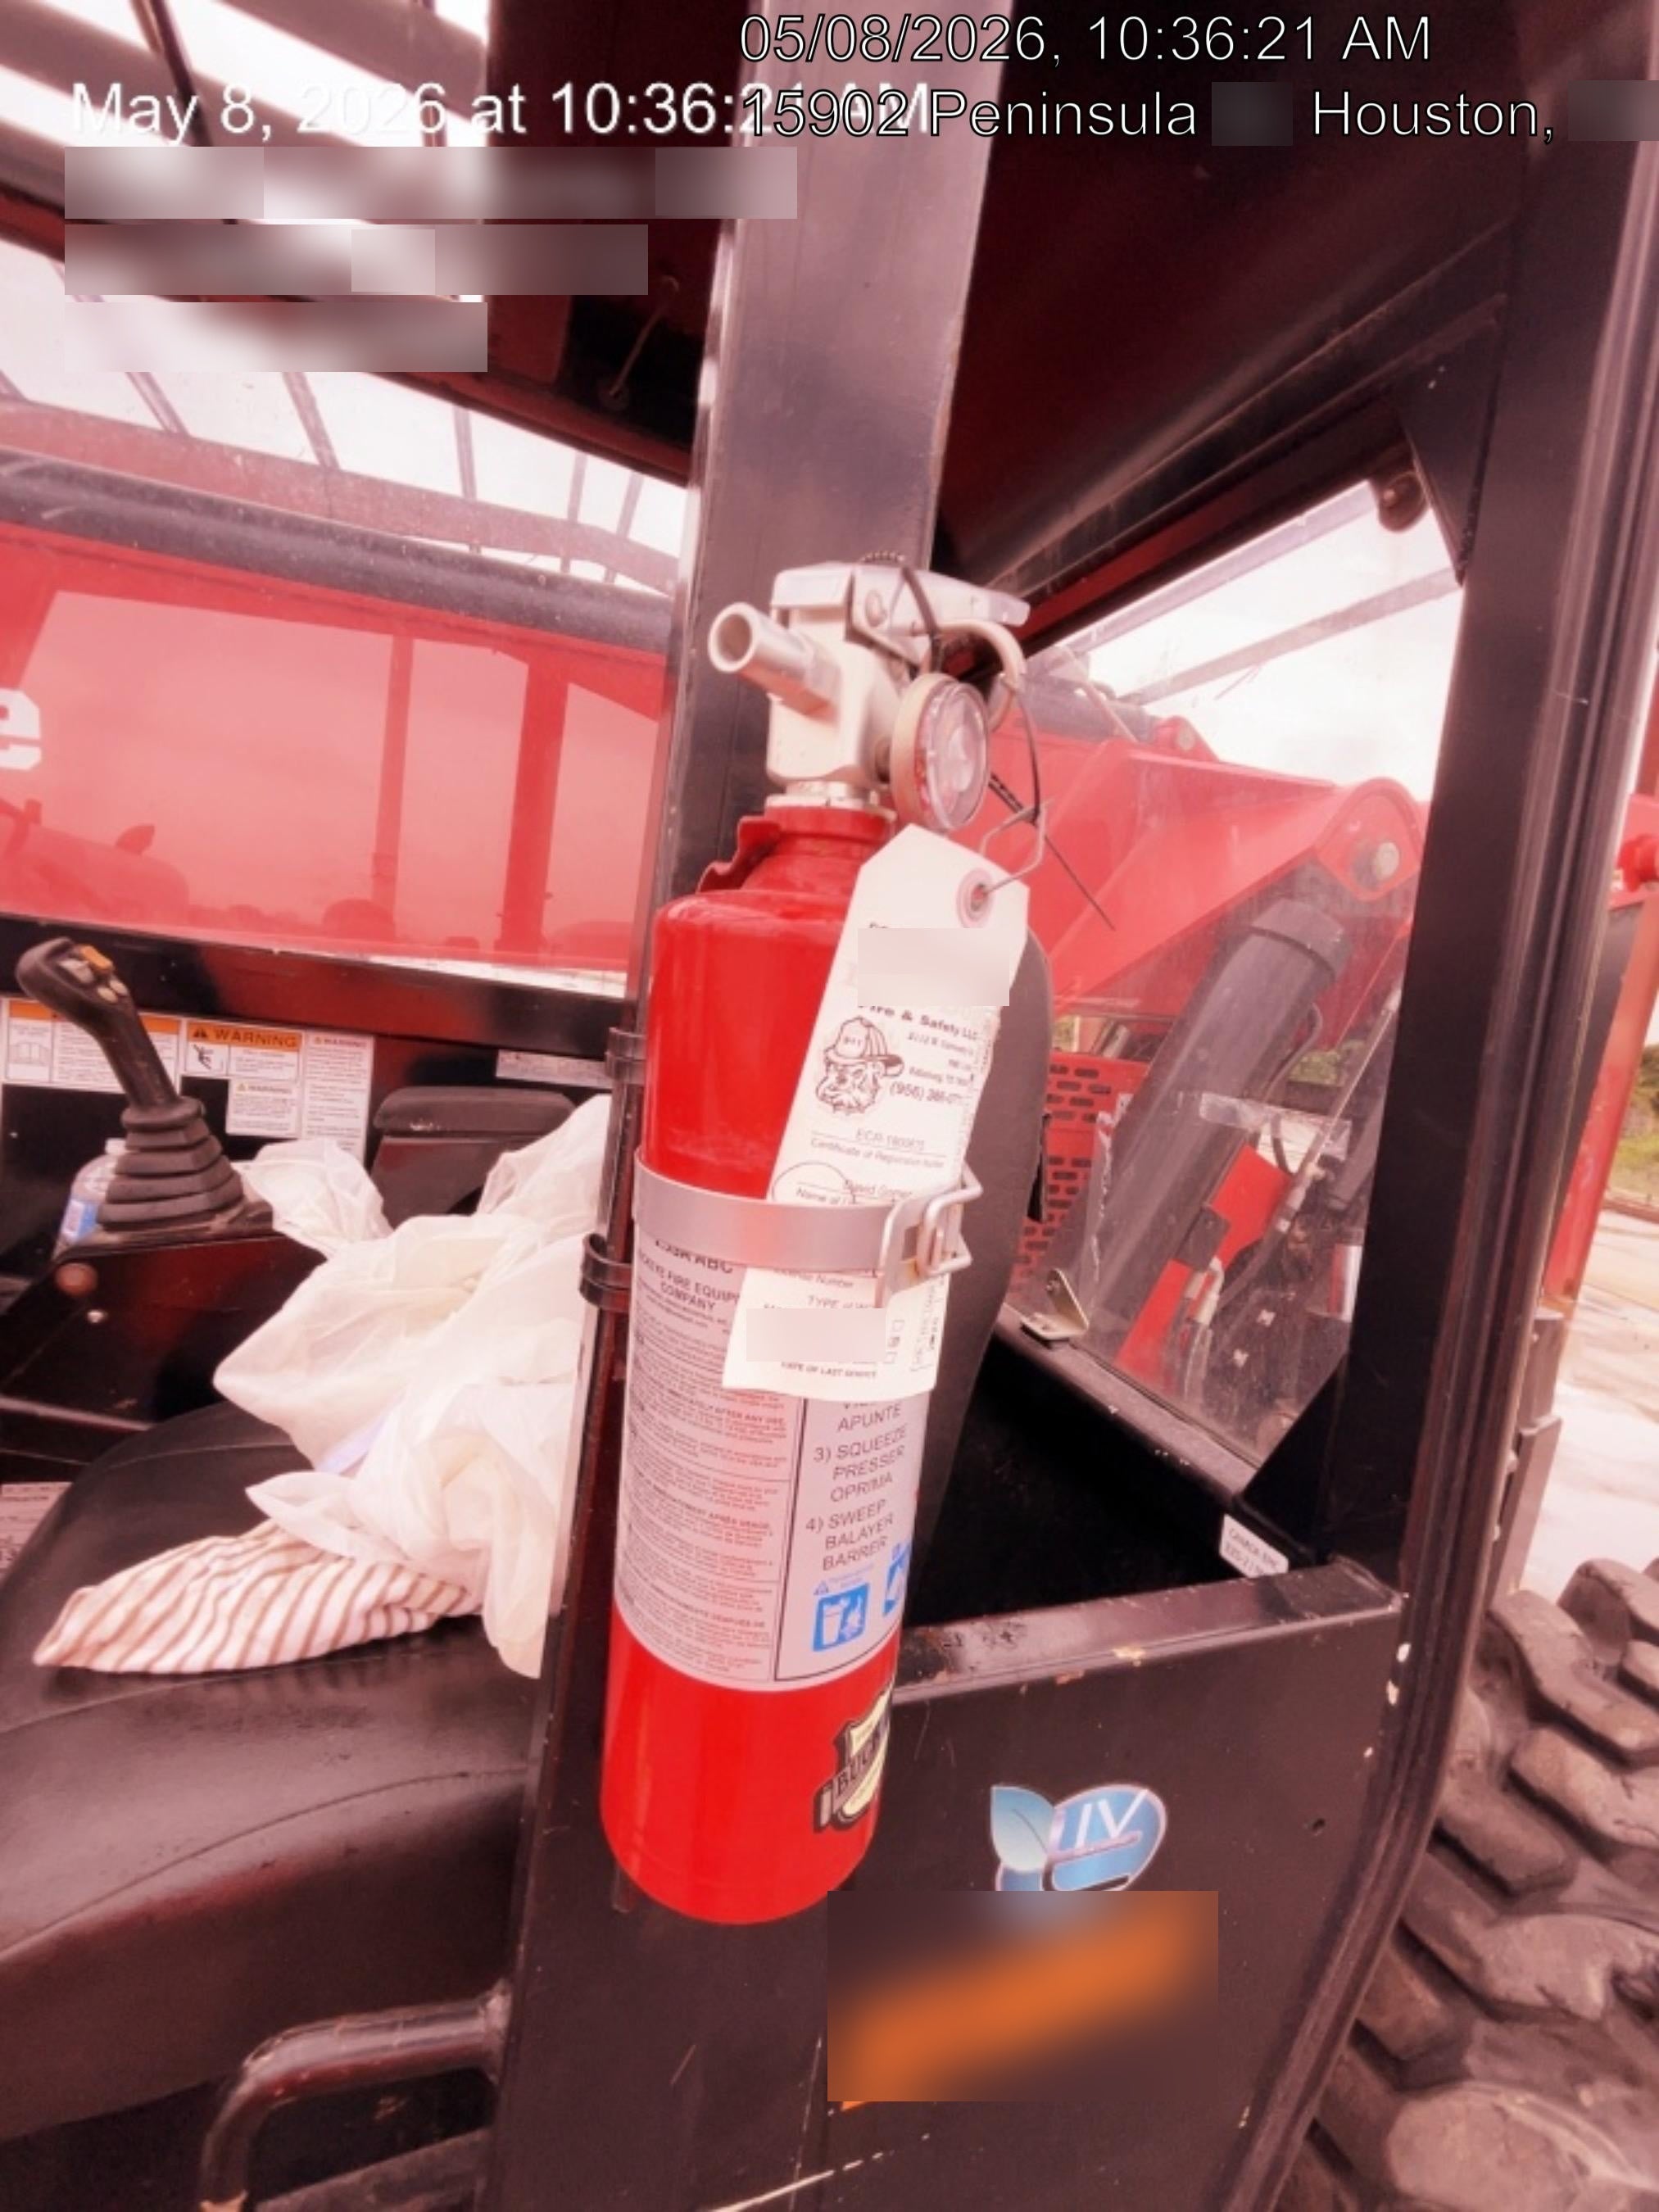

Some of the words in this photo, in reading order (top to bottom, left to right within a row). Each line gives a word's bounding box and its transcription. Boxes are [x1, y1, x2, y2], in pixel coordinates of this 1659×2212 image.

[215, 1028, 297, 1047] WARNING
[836, 1401, 901, 1432] APUNTE
[814, 1446, 832, 1463] 3)
[832, 1444, 905, 1480] PRESSER
[830, 1471, 893, 1503] OPRIMA
[805, 1516, 824, 1534] 4)
[827, 1498, 886, 1530] SWEEP
[823, 1535, 888, 1571] BARRER
